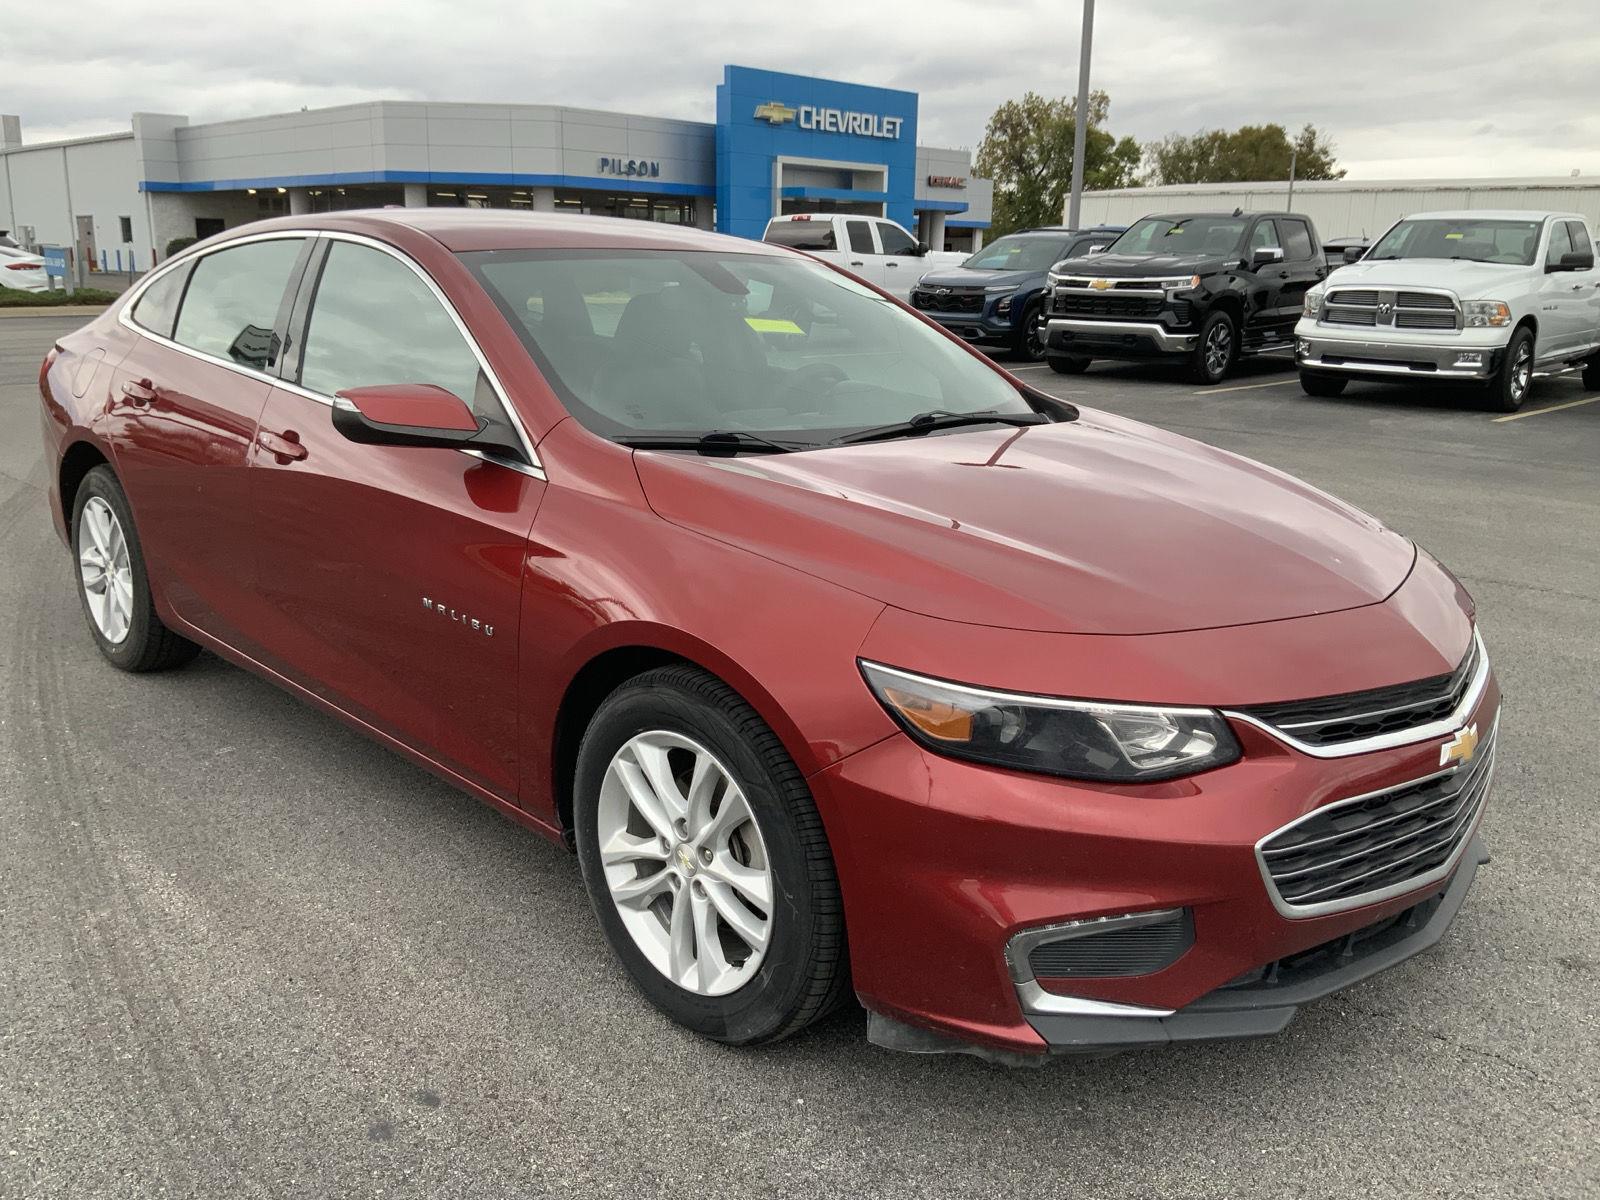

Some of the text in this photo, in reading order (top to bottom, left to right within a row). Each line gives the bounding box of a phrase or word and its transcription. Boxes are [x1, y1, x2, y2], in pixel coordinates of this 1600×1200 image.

[800, 105, 903, 139] CHEVROLET
[599, 157, 659, 177] PILSON
[422, 597, 494, 636] MALIBU
